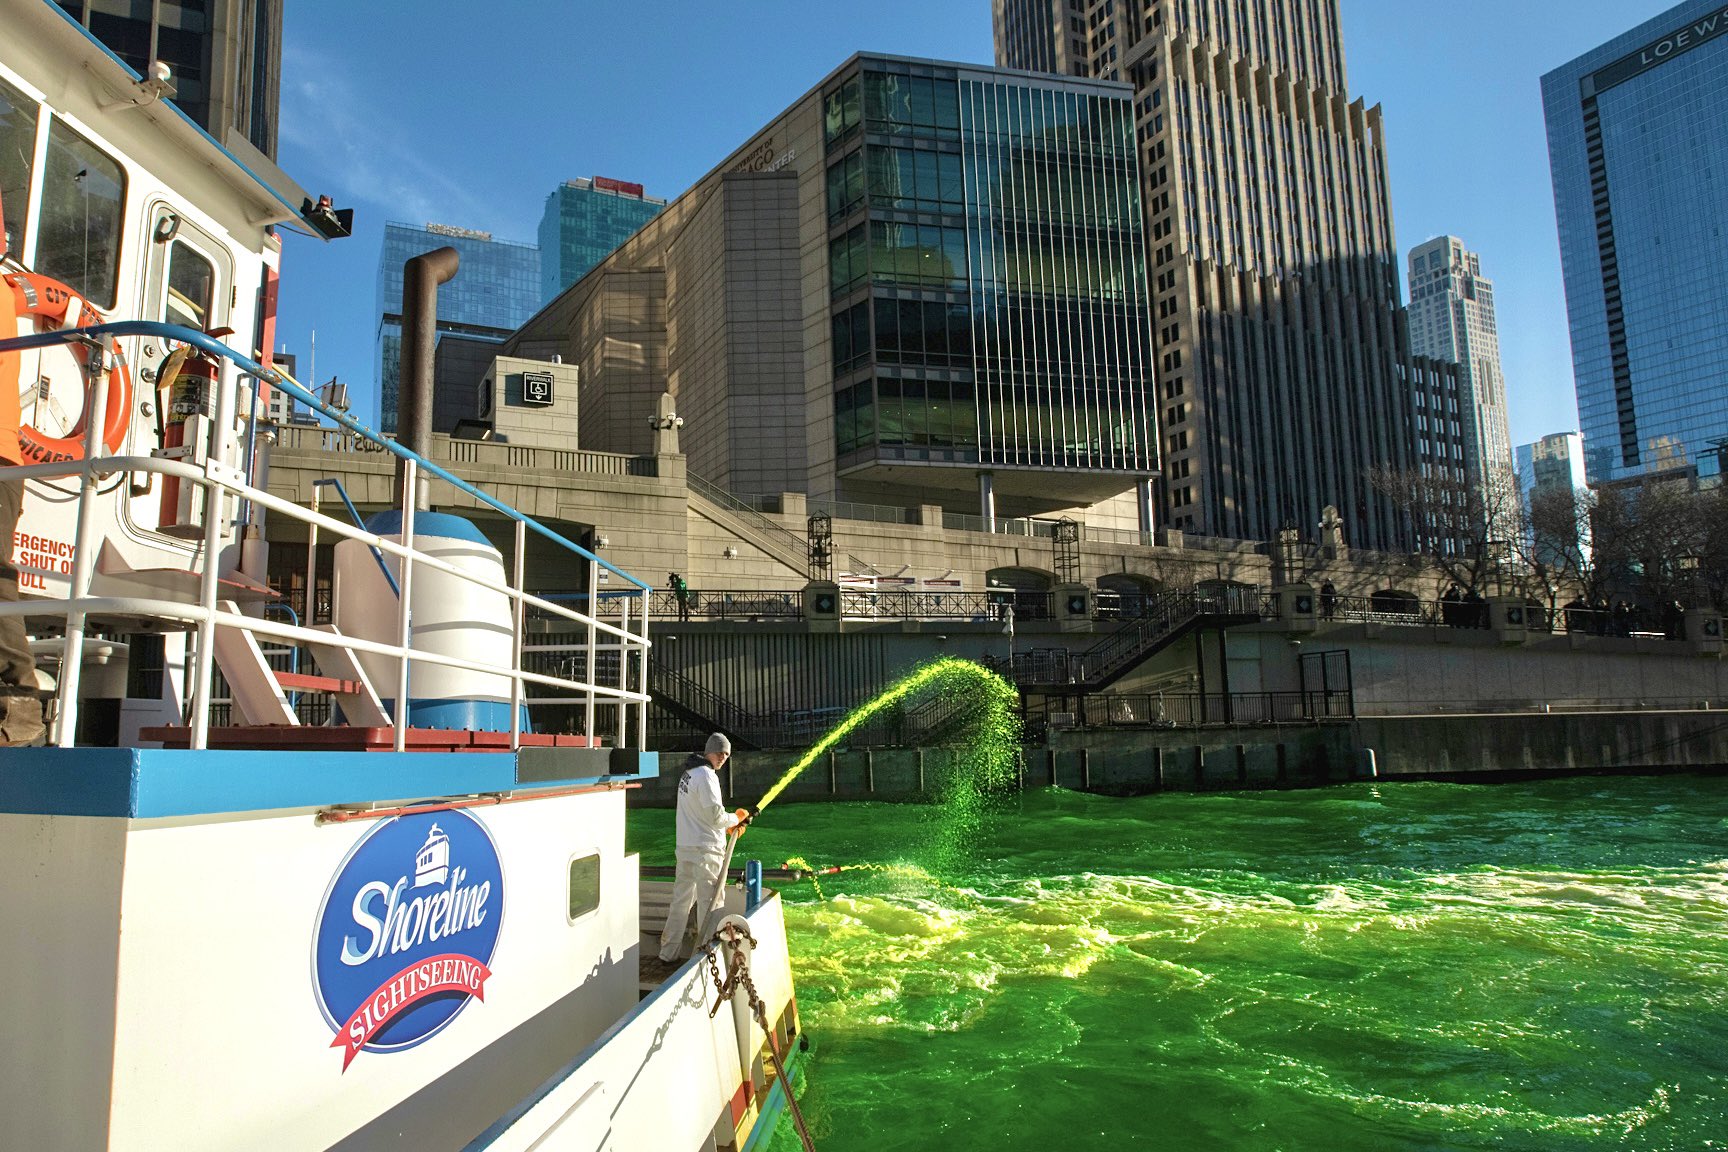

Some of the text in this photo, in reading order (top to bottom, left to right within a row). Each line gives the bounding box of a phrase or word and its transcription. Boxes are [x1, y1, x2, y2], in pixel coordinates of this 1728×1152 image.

[13, 532, 76, 558] ERGENCY
[20, 551, 57, 571] SHUT
[18, 571, 47, 590] ULL
[340, 866, 490, 965] Shoreline
[350, 959, 482, 1050] SIGHTSEEING
